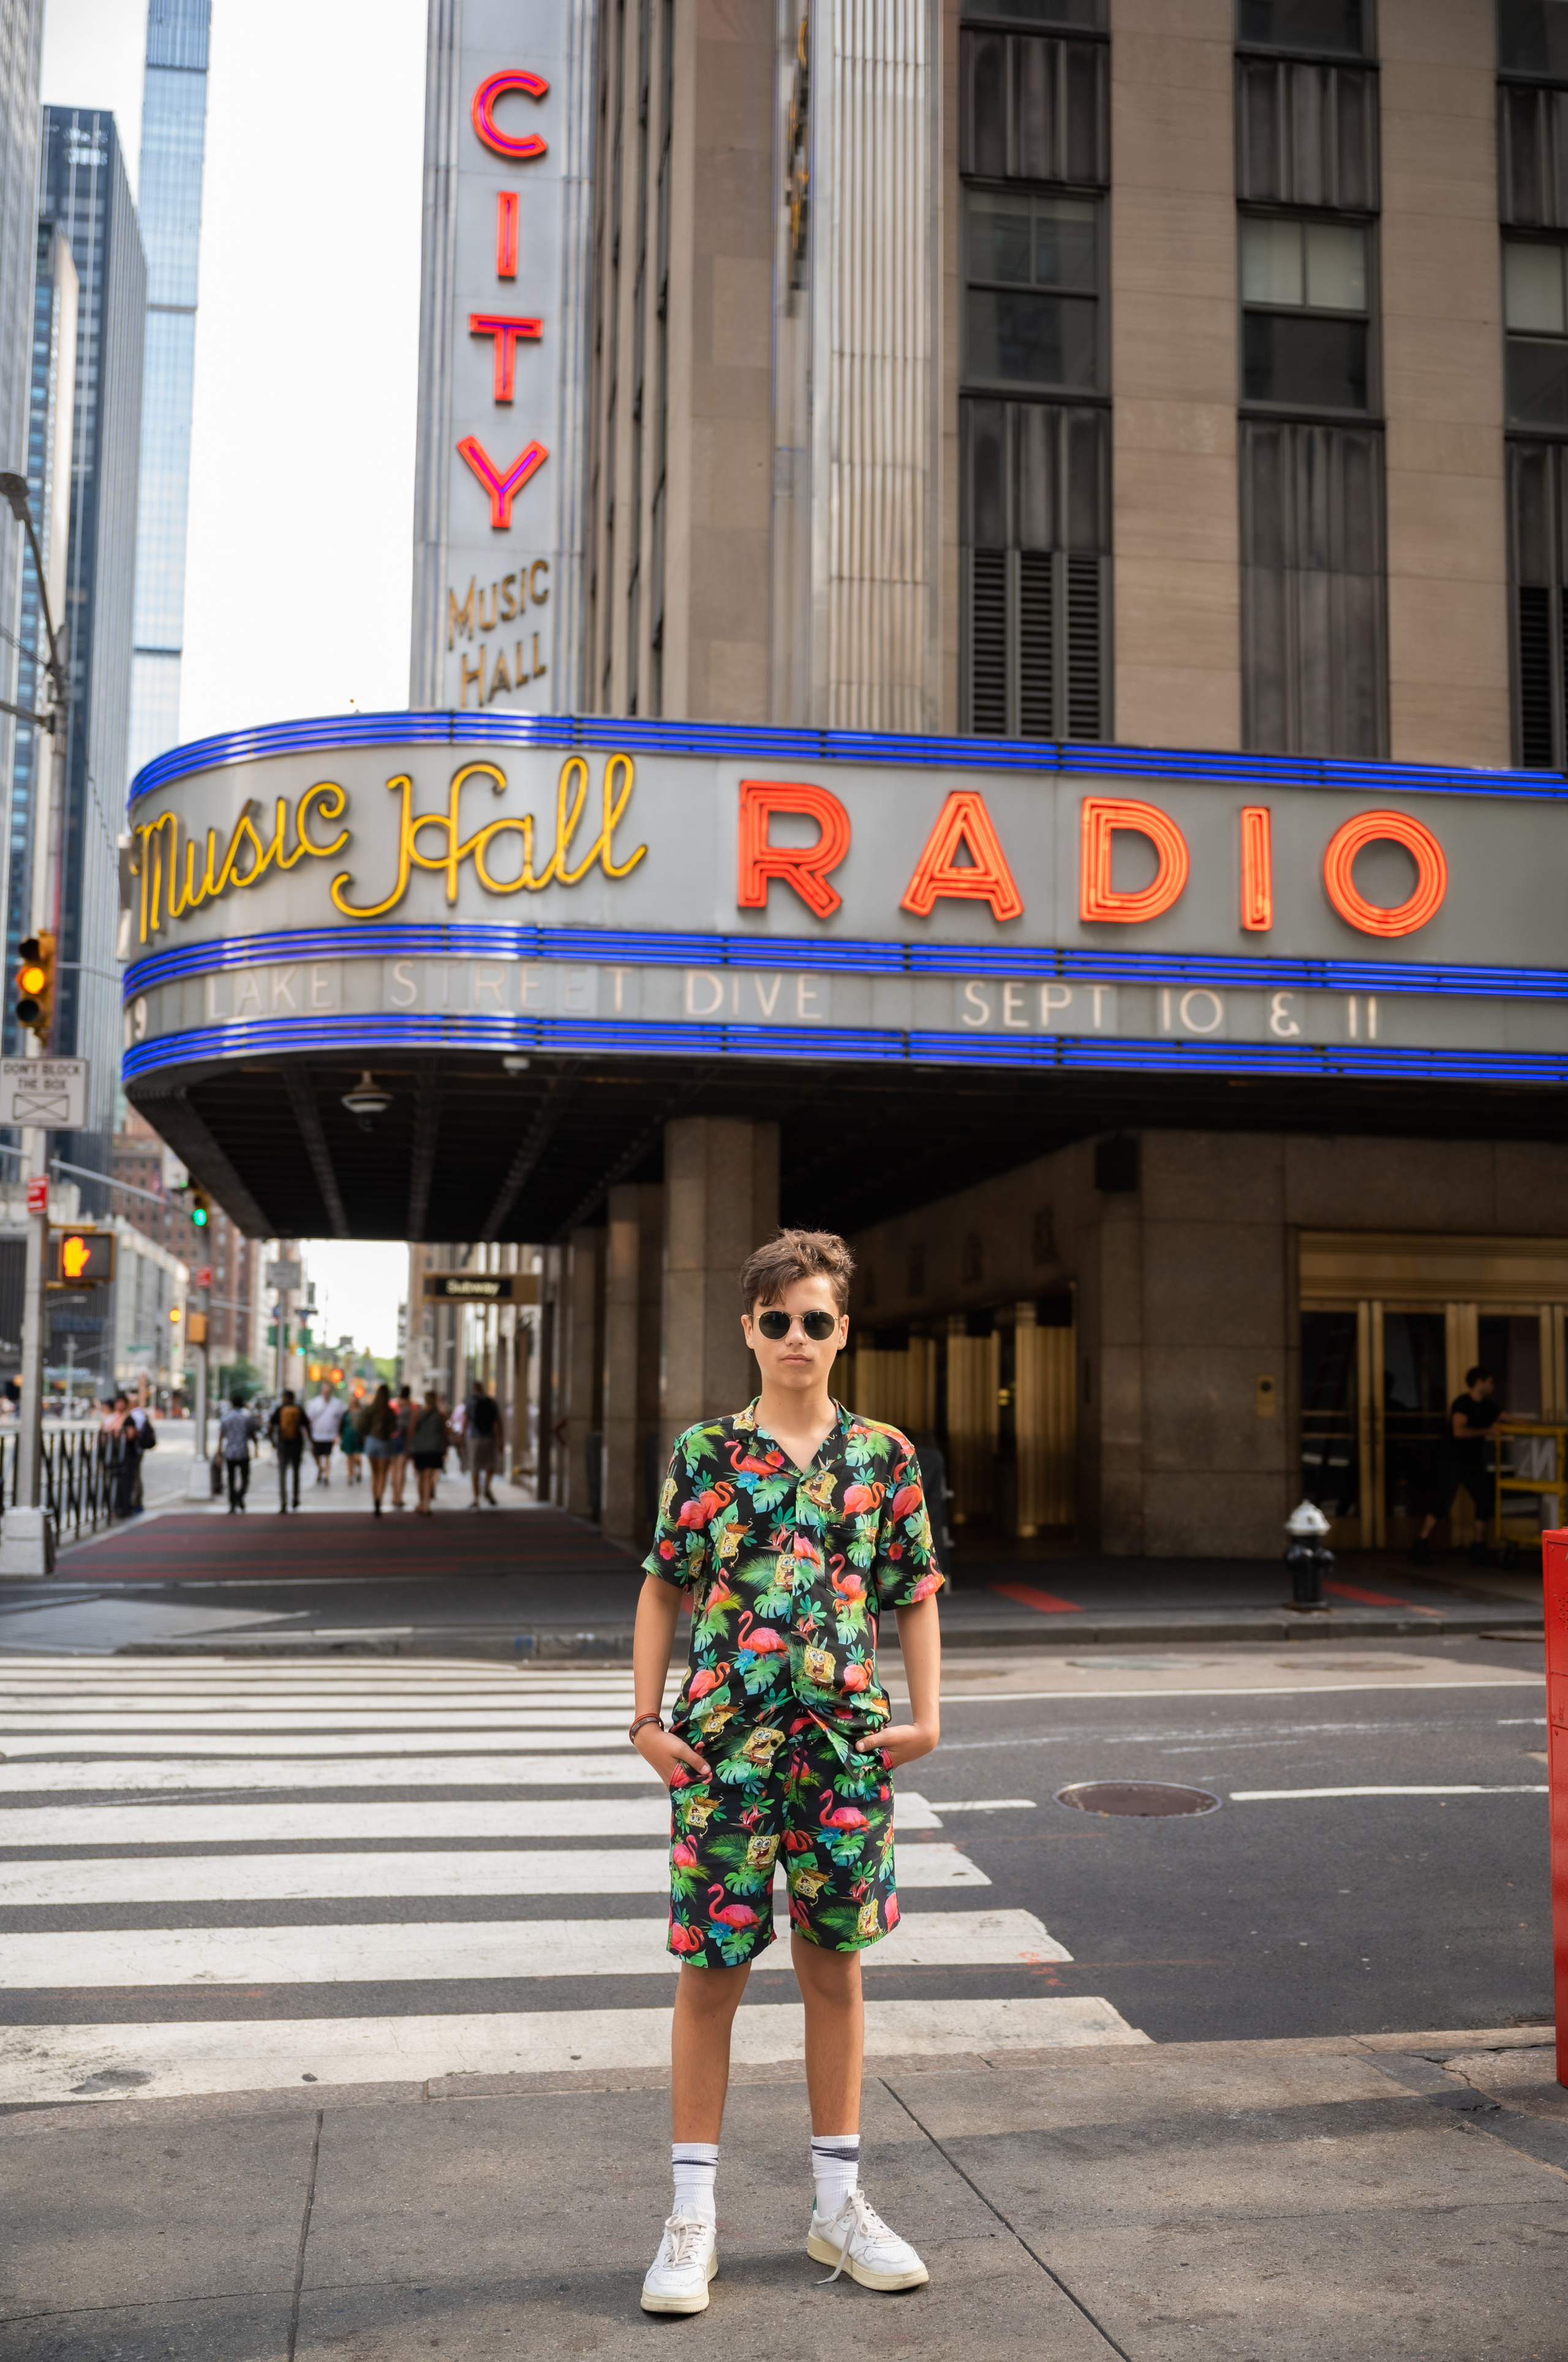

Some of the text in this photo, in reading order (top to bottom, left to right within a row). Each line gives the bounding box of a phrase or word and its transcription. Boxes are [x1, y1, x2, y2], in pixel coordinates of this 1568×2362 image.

[457, 69, 549, 528] CITY
[448, 559, 549, 652] MUSIC
[461, 632, 546, 709] HALL
[130, 752, 648, 943] Music Hall
[737, 779, 1449, 938] RADIO
[208, 959, 1377, 1040] LAKE STREET DIVE SEPT 10 & 11
[4, 1063, 81, 1076] DON'T BLOCK
[18, 1077, 67, 1090] THE BOX
[445, 1278, 500, 1297] Subway
